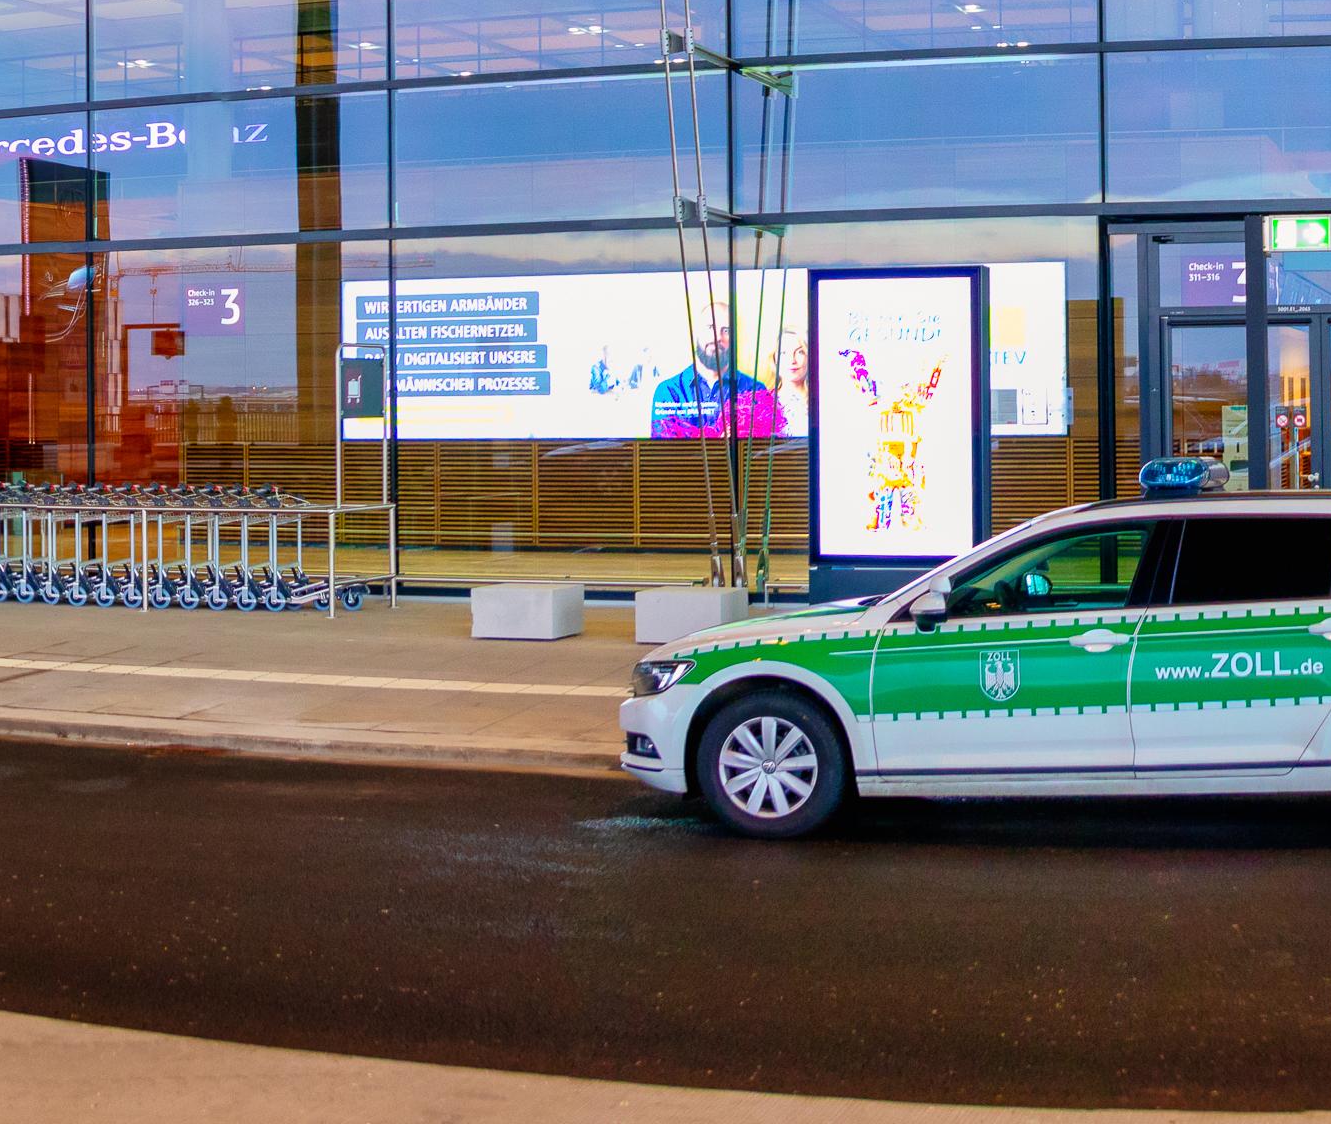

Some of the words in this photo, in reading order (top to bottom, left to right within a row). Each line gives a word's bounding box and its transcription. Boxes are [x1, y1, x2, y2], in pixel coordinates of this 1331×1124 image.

[1189, 262, 1224, 271] Check-in
[187, 288, 215, 297] Check-in
[220, 288, 240, 325] 3
[364, 301, 389, 314] WIR
[396, 299, 447, 314] ERTIGEN
[450, 296, 528, 312] ARMBÄNDER
[364, 327, 389, 340] AUS
[396, 326, 429, 339] LTEN
[431, 323, 527, 338] FISCHERNETZEN.
[404, 351, 487, 366] DIGITALISIERT
[489, 350, 536, 364] UNSERE
[386, 376, 474, 392] MÄNNISCHEN
[477, 377, 540, 391] PROZESSE.
[987, 651, 1011, 662] ZOLL
[1155, 650, 1324, 680] www.ZOLL.de
